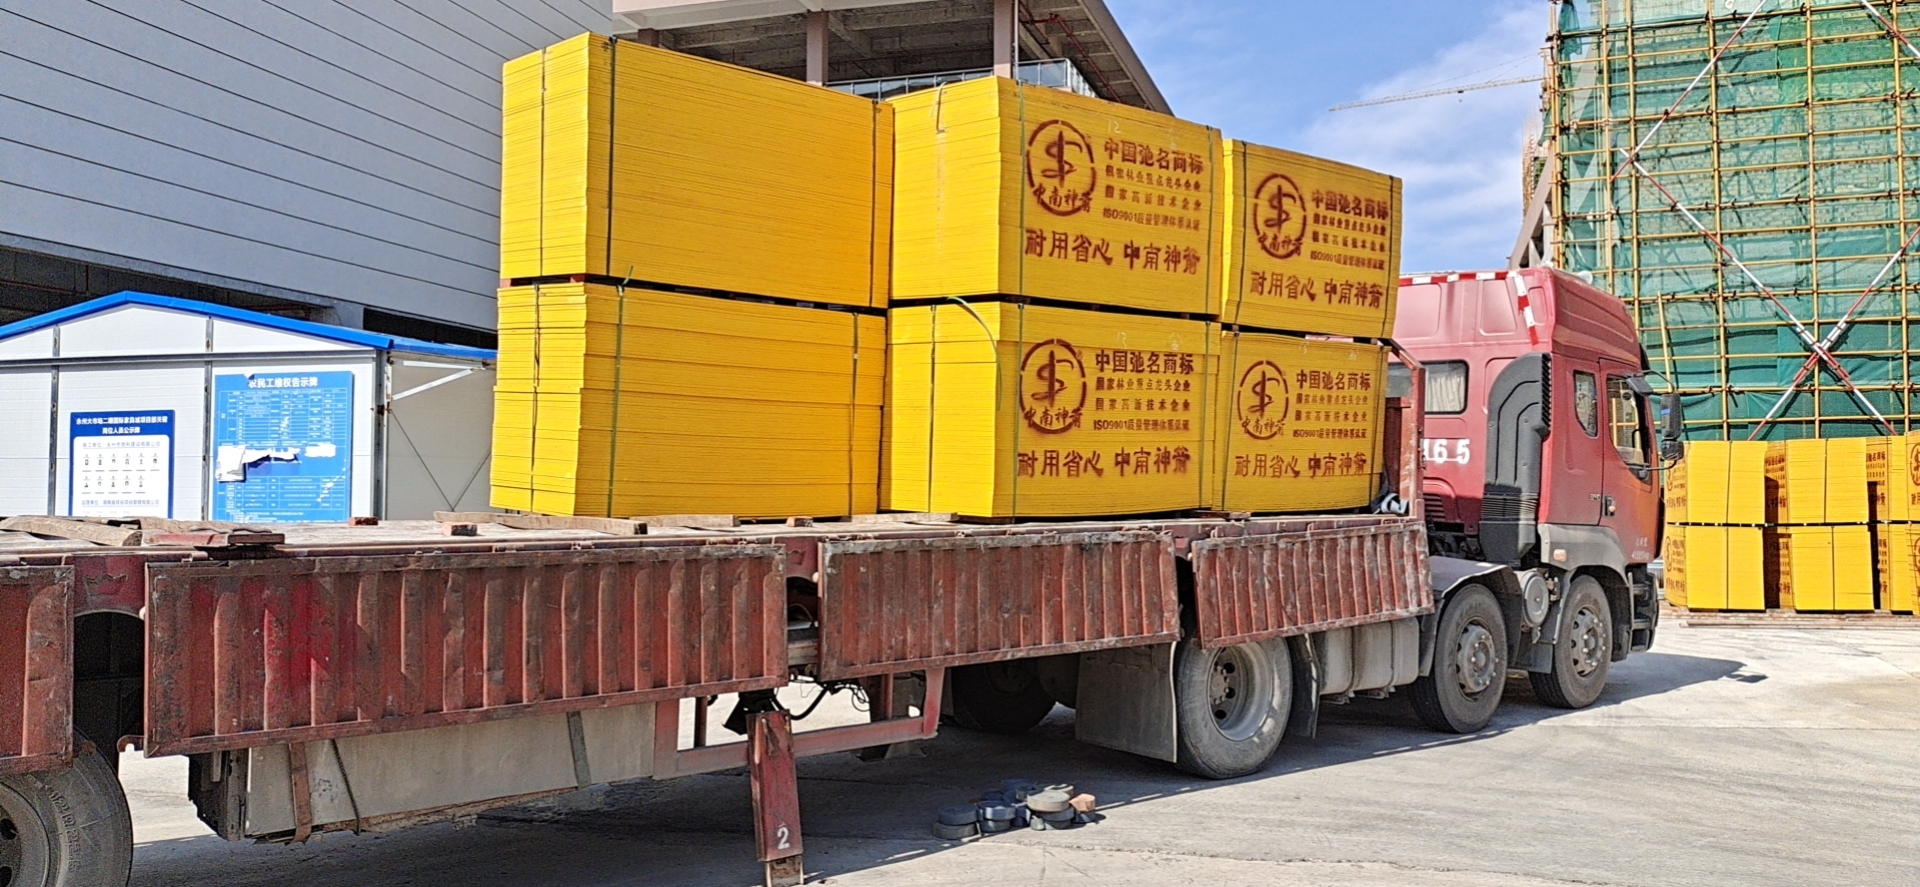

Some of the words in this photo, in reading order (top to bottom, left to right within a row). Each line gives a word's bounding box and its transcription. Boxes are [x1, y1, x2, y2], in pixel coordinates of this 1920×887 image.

[1025, 229, 1113, 266] 耐用省心
[1250, 271, 1317, 302] 耐用省心
[248, 376, 318, 389] 农民工维权告示牌
[102, 427, 140, 435] 岗位人员公示牌
[1017, 450, 1104, 478] 耐用省心
[1235, 453, 1300, 478] 耐用省心
[777, 827, 790, 850] 2
